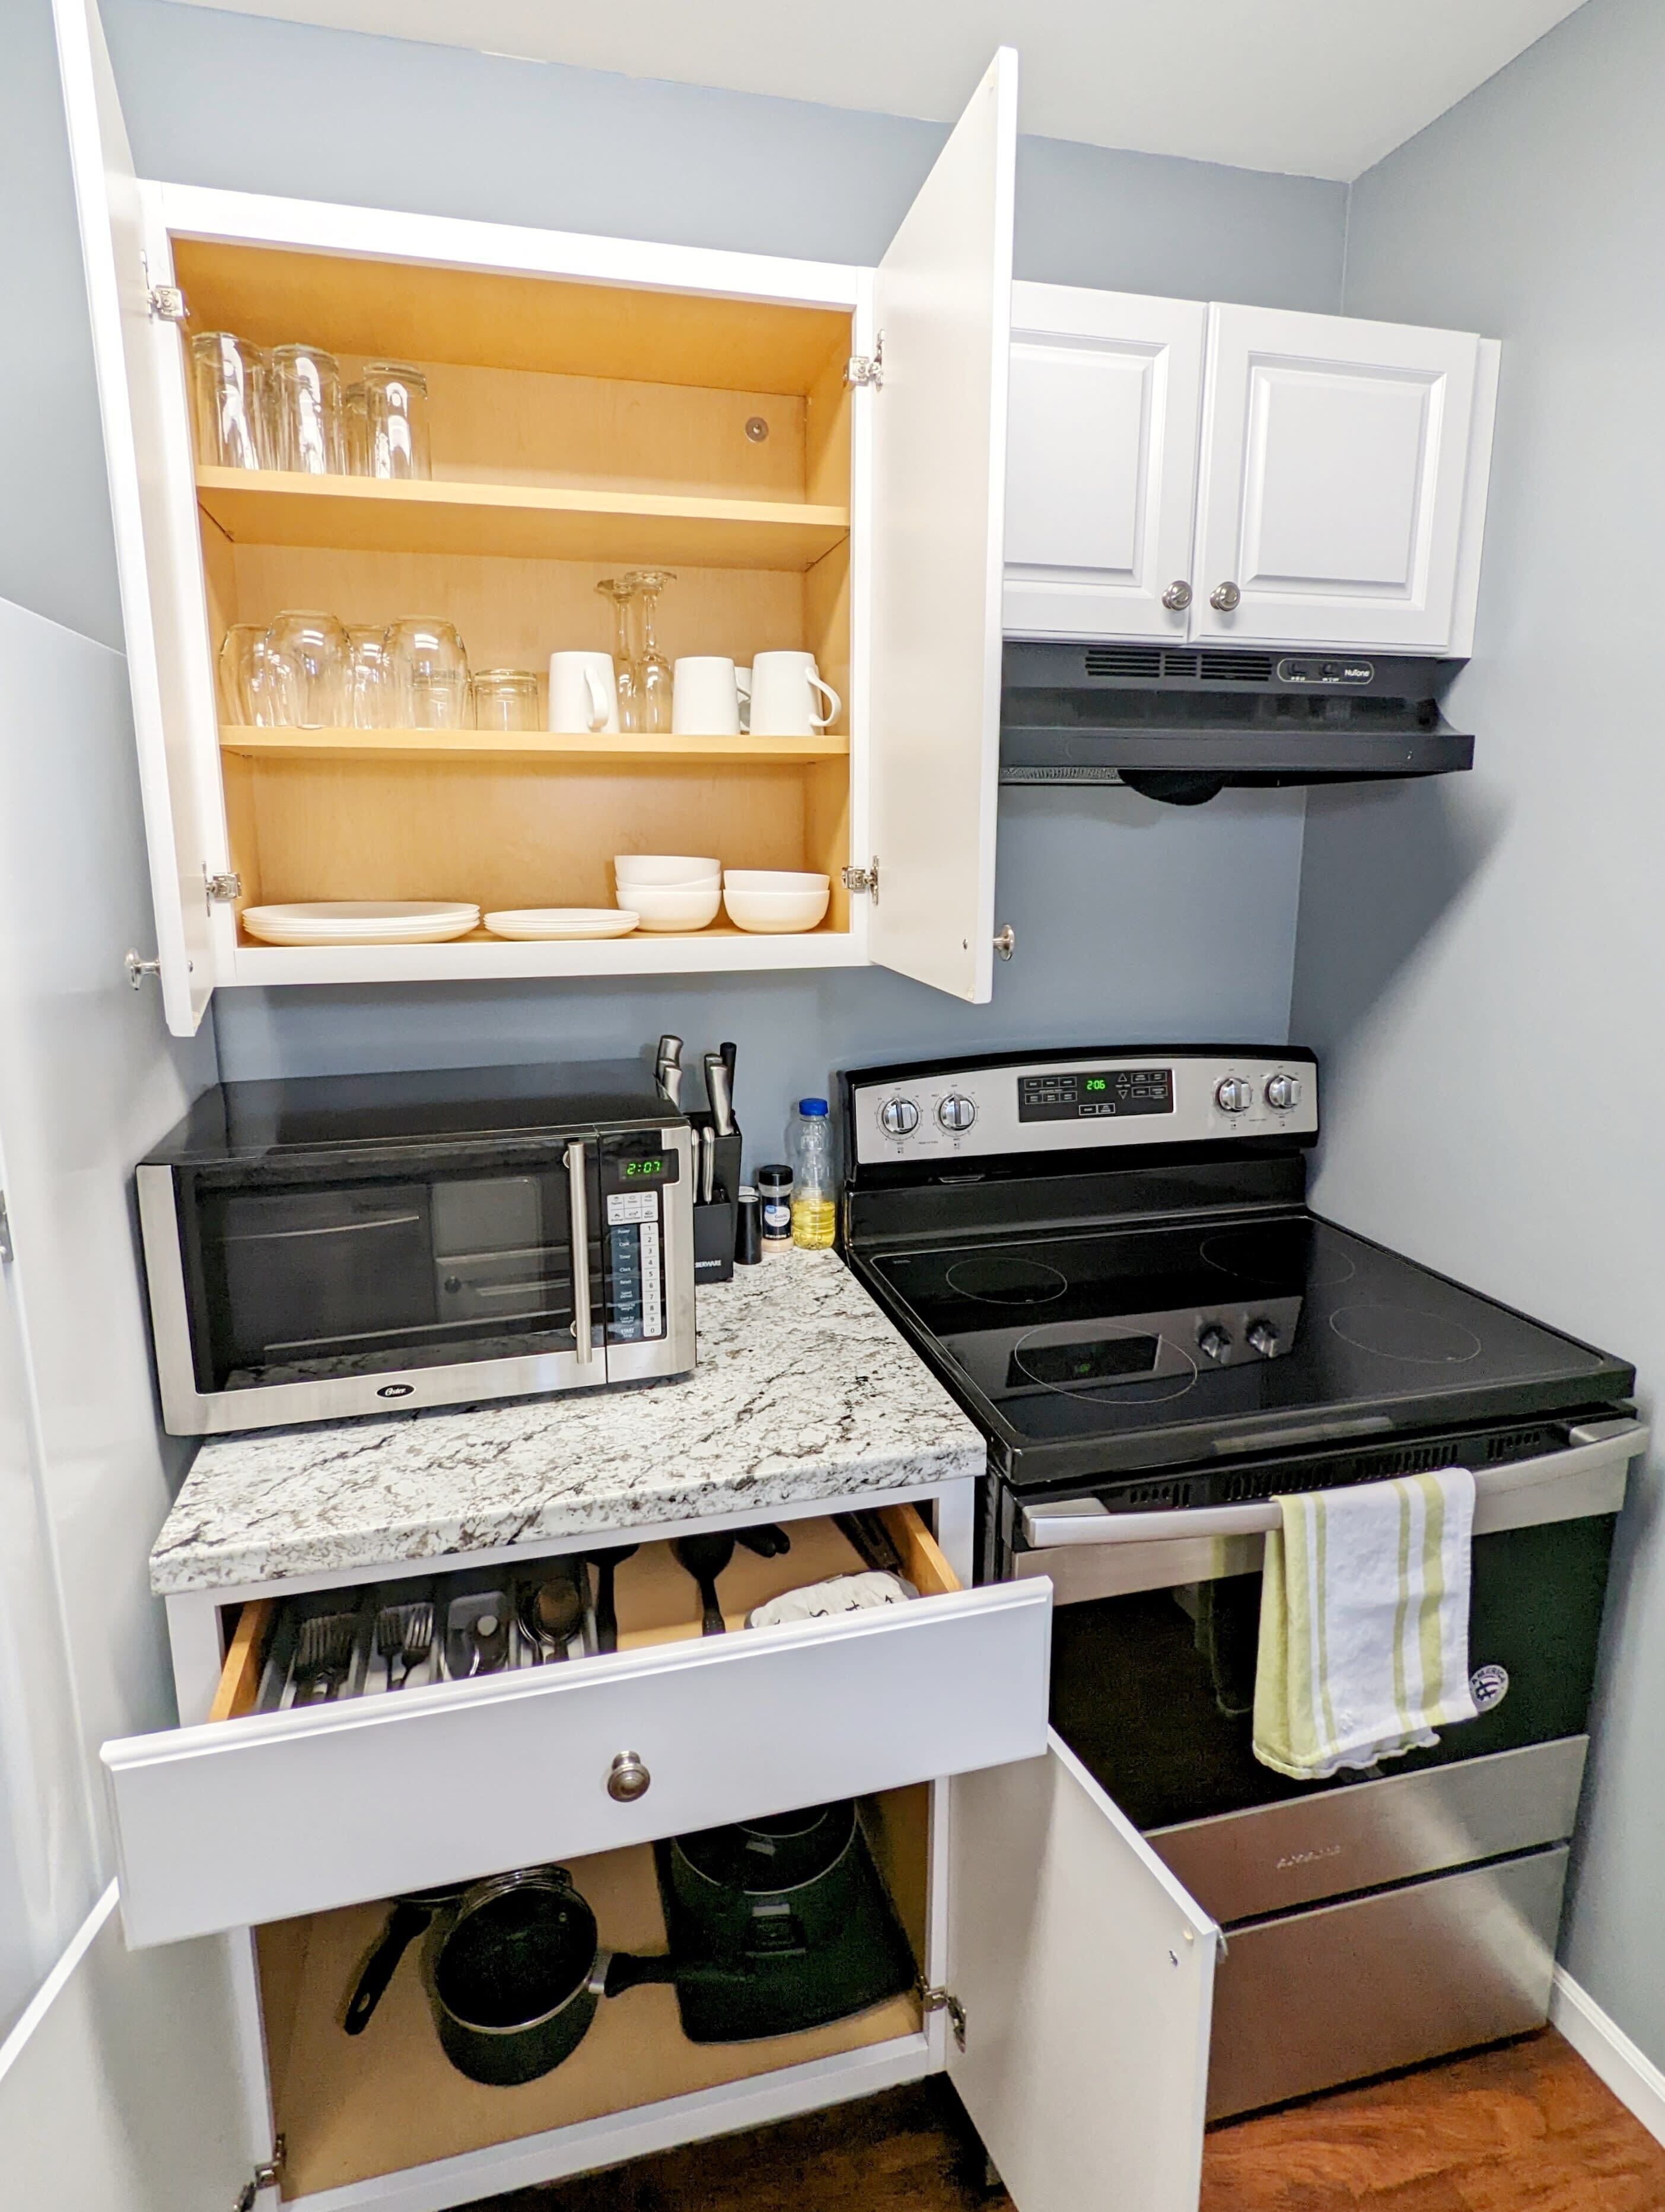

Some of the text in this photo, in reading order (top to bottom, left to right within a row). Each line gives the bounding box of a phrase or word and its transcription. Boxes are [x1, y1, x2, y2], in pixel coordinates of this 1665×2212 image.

[1345, 669, 1370, 677] NuTone
[626, 1161, 660, 1175] 2:07
[695, 1260, 722, 1268] BERWARE
[384, 1388, 407, 1397] Oster
